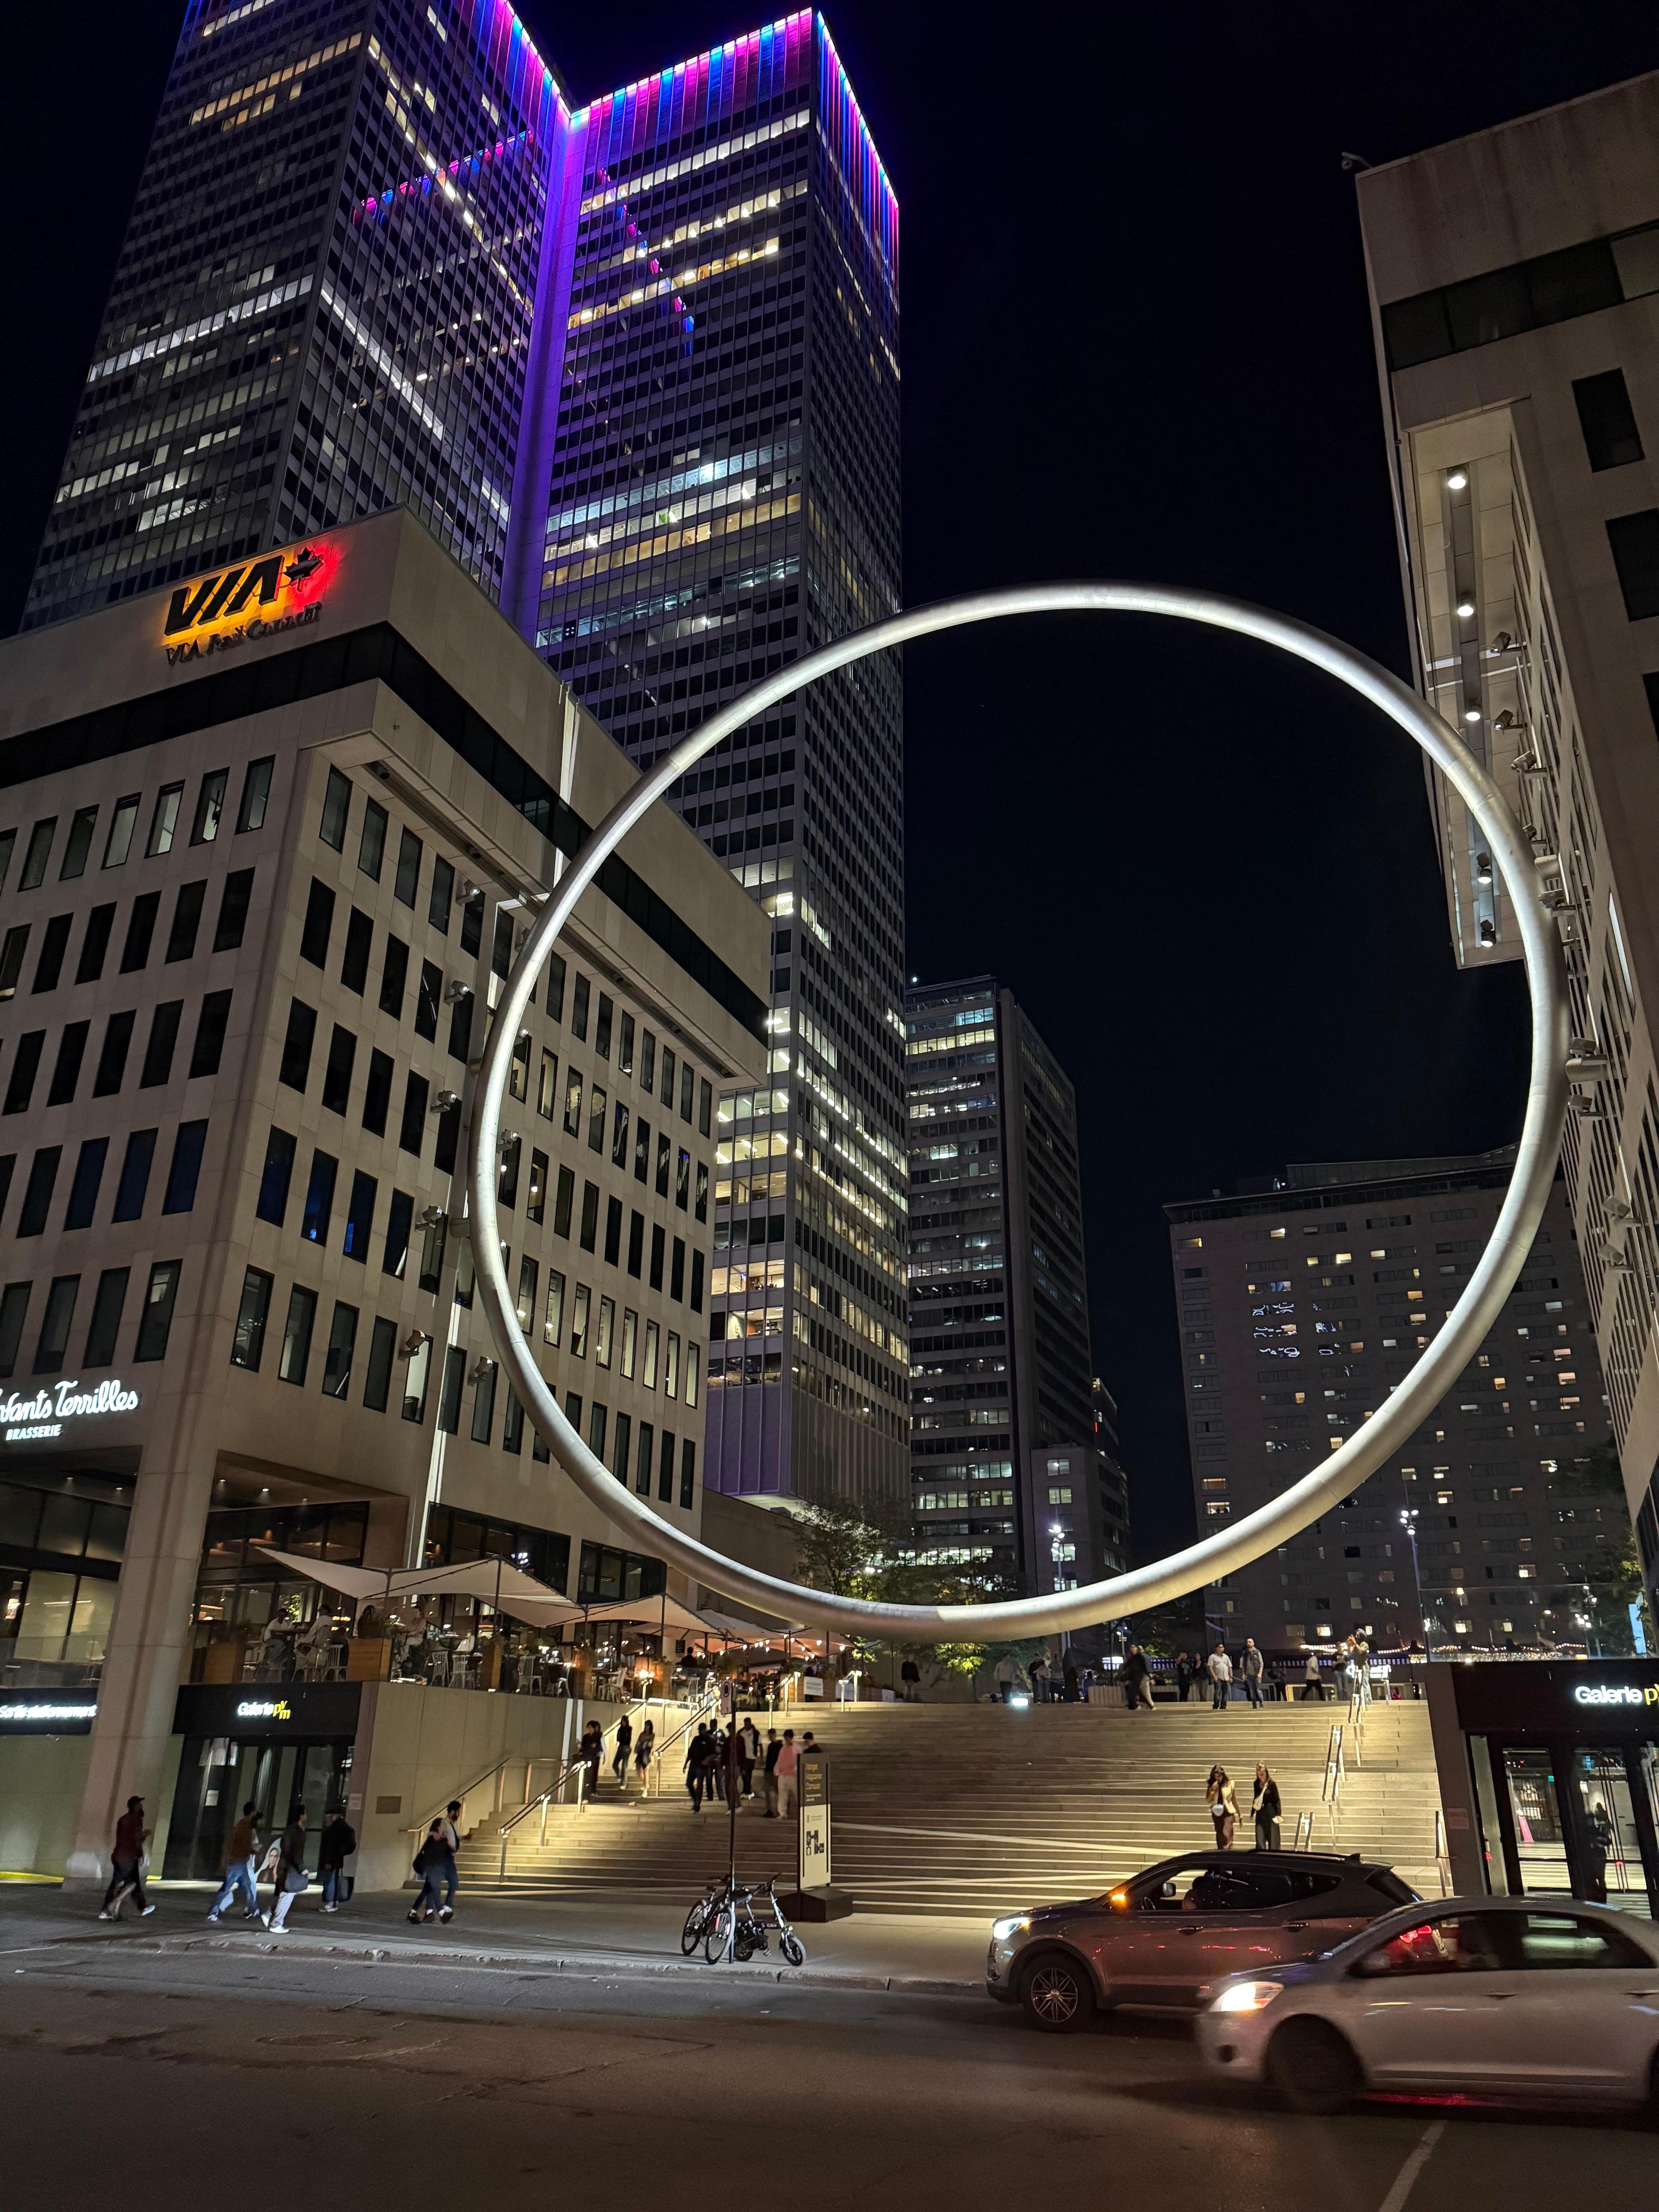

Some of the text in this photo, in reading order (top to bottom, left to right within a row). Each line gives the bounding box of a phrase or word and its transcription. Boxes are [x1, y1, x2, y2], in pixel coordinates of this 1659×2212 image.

[164, 555, 285, 636] VIA
[55, 1380, 138, 1417] Terribles
[5, 1424, 62, 1441] BRASSERIE
[1575, 1685, 1643, 1703] Galerie
[238, 1702, 274, 1716] Galerie
